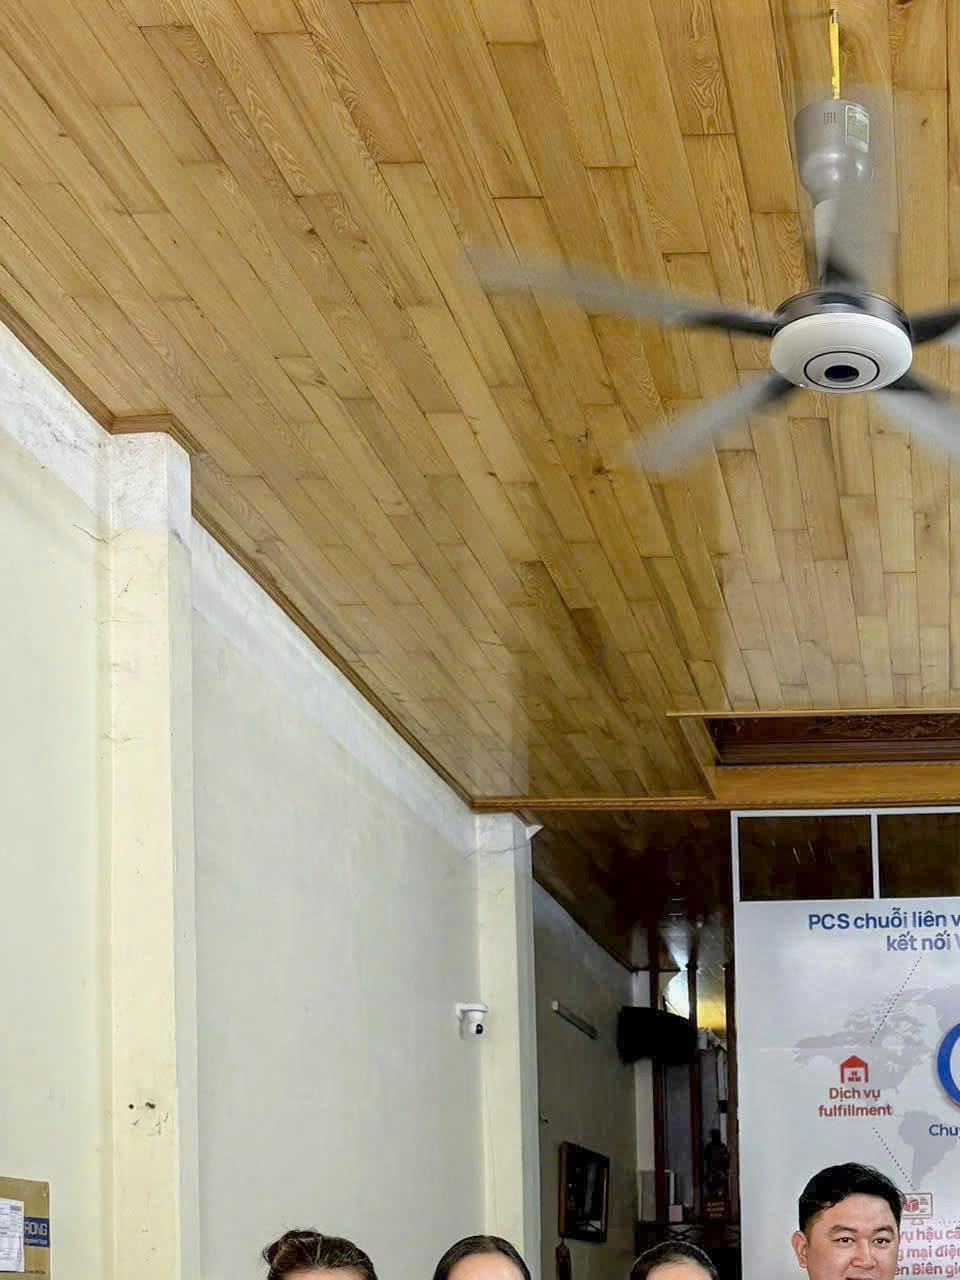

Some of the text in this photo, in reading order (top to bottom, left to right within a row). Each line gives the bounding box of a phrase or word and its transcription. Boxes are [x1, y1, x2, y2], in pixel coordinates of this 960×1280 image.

[808, 913, 850, 930] PCS
[853, 907, 908, 930] chuỗi
[911, 910, 947, 928] liên
[886, 930, 918, 951] kết
[921, 930, 951, 951] nối
[828, 1087, 881, 1102] Dịch vụ
[818, 1103, 893, 1117] fulfillment
[25, 1221, 48, 1236] RONG
[916, 1226, 943, 1243] hậu
[907, 1244, 933, 1261] mại
[911, 1262, 943, 1276] Biên
